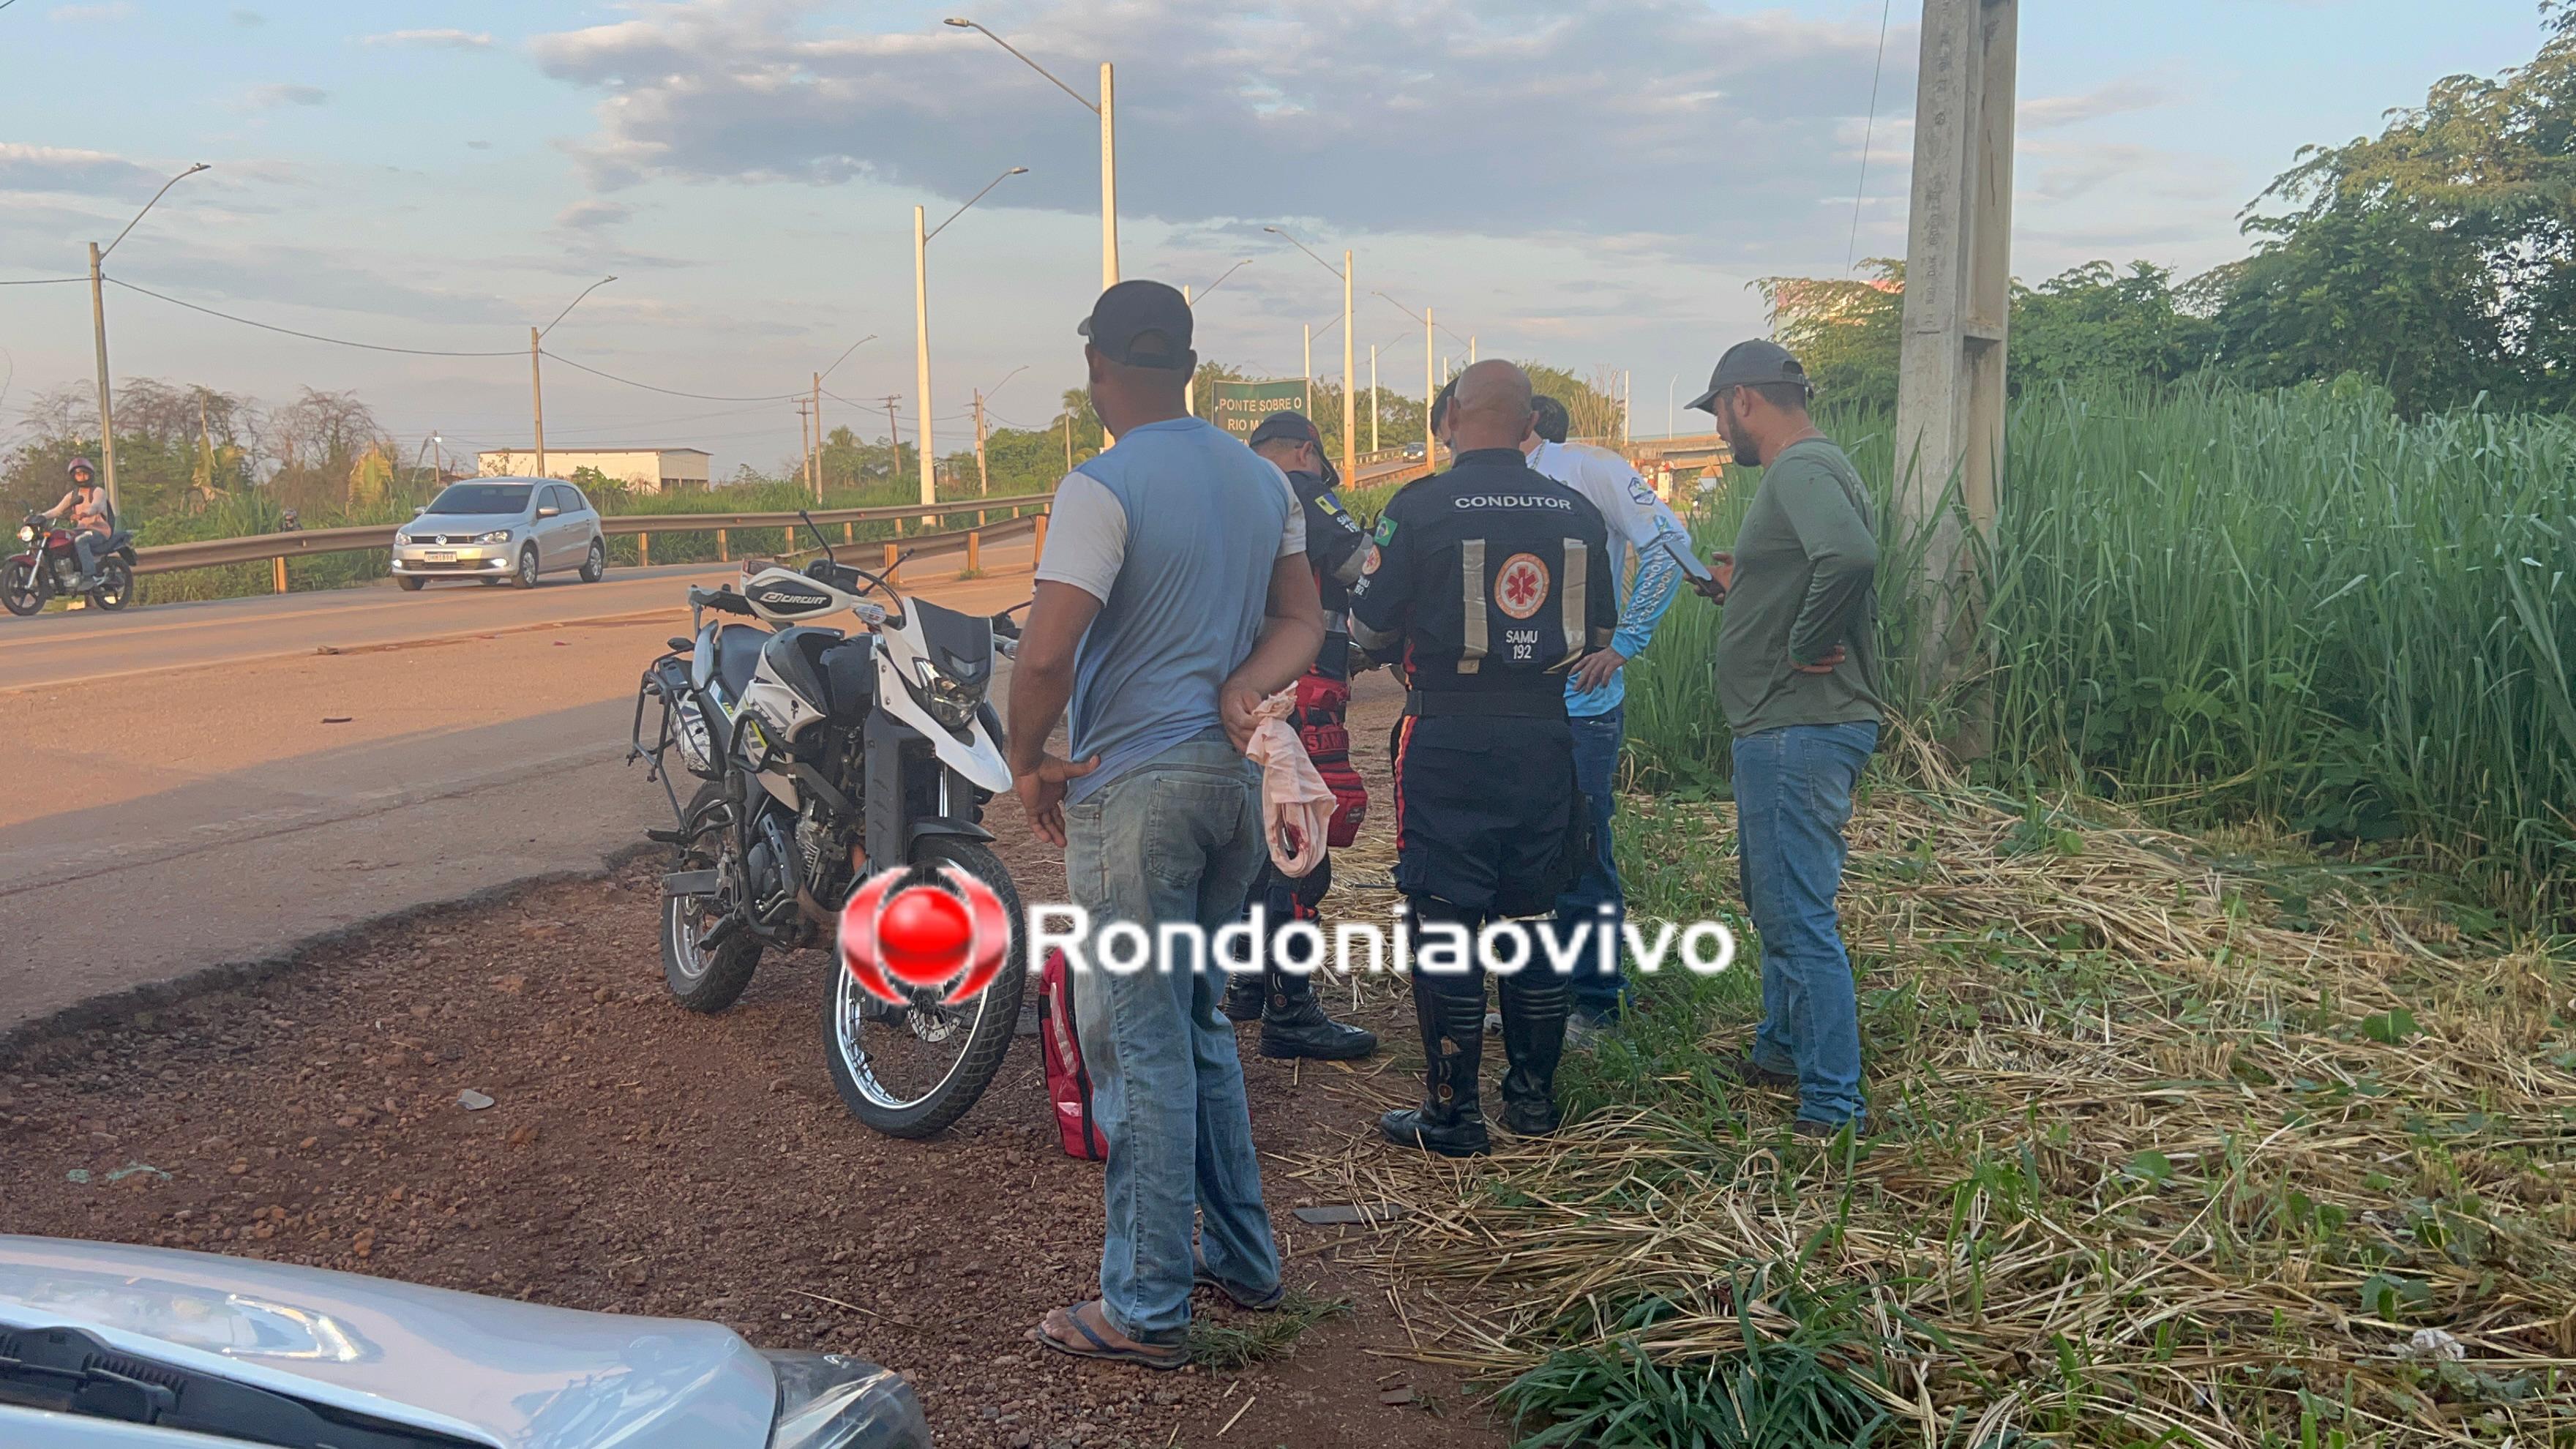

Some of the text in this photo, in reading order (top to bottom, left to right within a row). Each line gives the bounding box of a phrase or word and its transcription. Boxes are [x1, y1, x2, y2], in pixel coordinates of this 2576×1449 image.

[1219, 397, 1302, 411] PONTE SOBRE O
[1228, 419, 1247, 431] RIO
[1455, 495, 1571, 510] CONDUTOR
[781, 594, 827, 604] CIRCUIT
[1505, 629, 1538, 644] SAMU
[1513, 644, 1532, 660] 192
